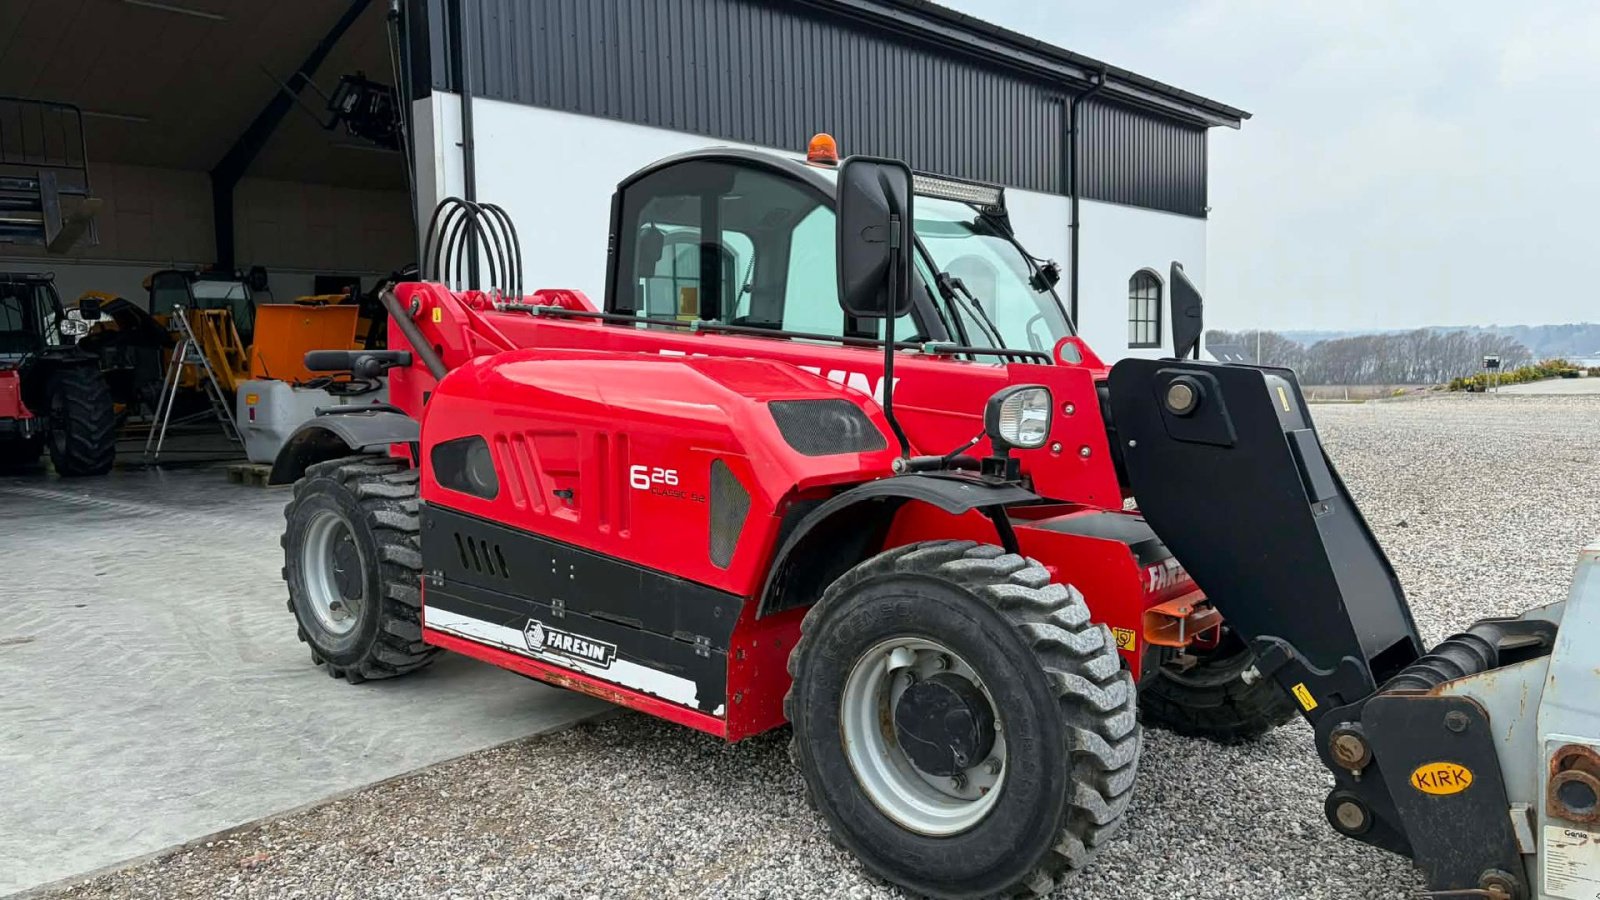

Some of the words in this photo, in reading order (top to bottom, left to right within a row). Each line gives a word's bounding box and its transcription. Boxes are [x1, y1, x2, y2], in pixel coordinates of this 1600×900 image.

[630, 464, 679, 490] 626
[651, 486, 688, 499] CLASSIC
[546, 631, 606, 661] FARESIN
[1415, 769, 1468, 789] KIRK
[1564, 829, 1588, 839] Genie
